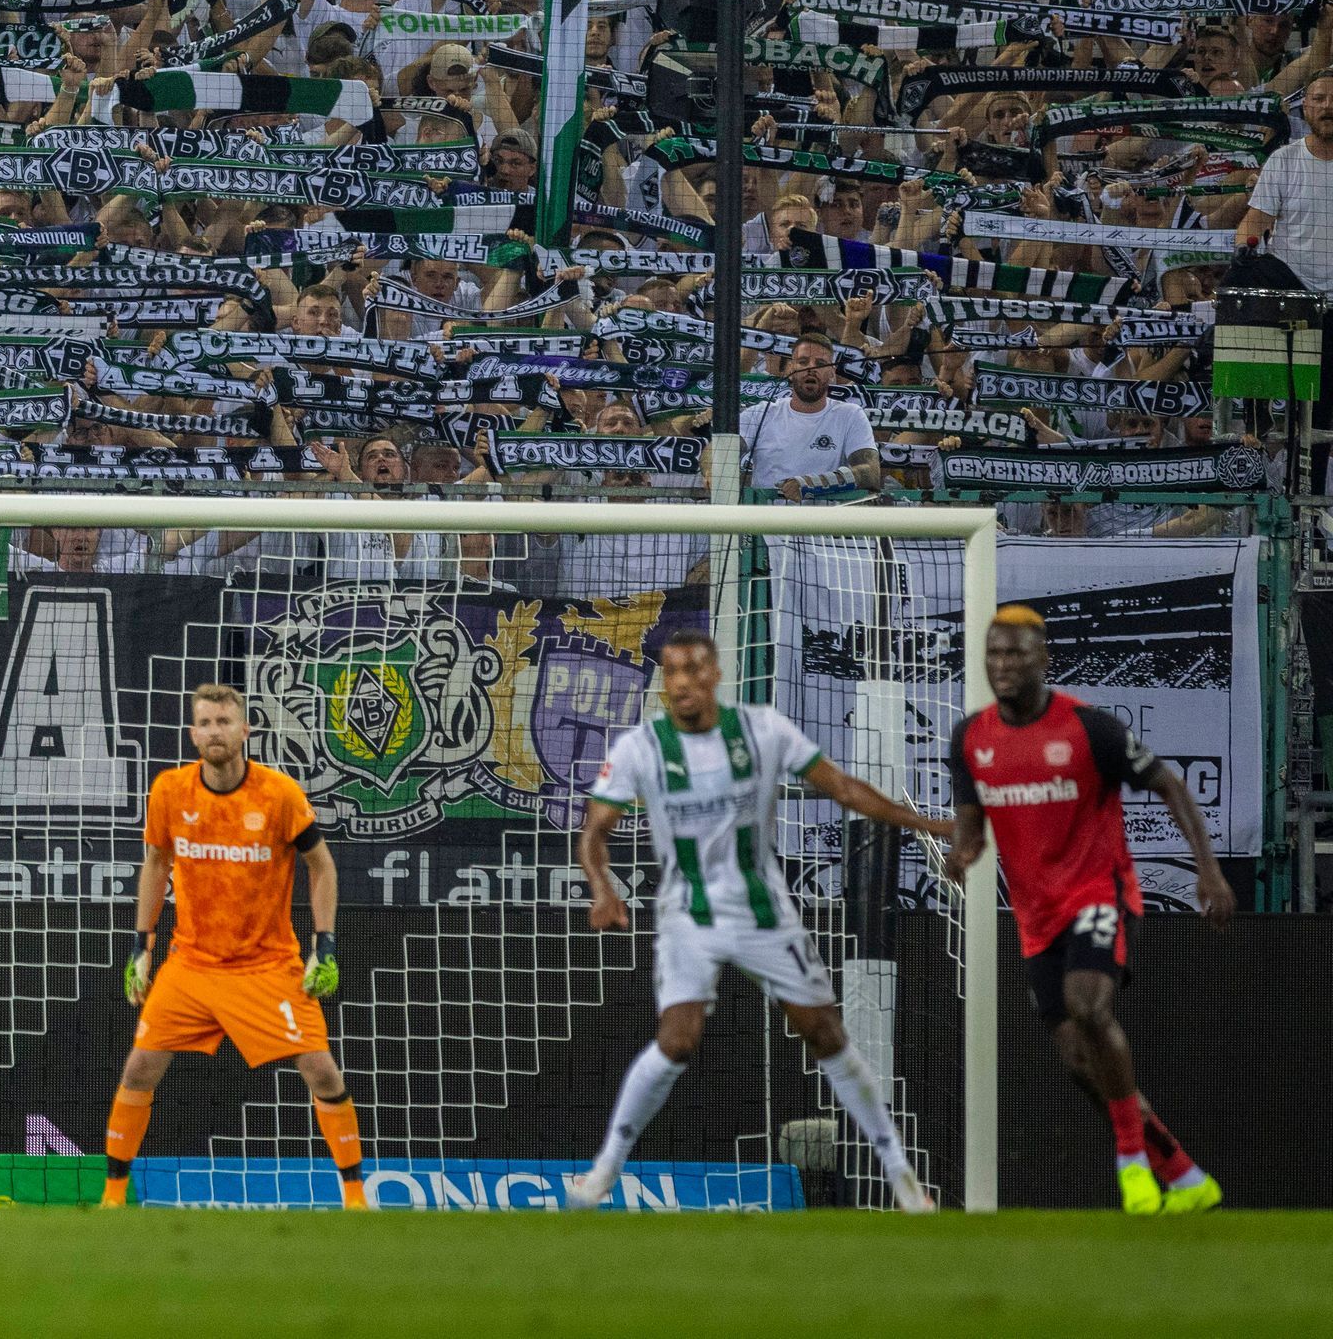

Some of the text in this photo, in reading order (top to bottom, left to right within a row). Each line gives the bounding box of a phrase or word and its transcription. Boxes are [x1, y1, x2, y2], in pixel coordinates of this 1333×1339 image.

[6, 23, 36, 31] SIEG
[942, 68, 1159, 86] BORUSSIA MÖNCHENGLADBACH
[1048, 103, 1087, 121] DIE
[404, 150, 477, 173] FANS
[163, 165, 294, 194] BORUSSIA
[10, 230, 86, 248] zusammen
[388, 234, 409, 253] &
[421, 233, 487, 262] VFL
[979, 374, 1125, 409] BORUSSIA
[500, 437, 643, 465] BORUSSIA
[947, 459, 1214, 494] GEMEINSAM für BORUSSIA
[546, 665, 638, 724] POLI
[174, 836, 272, 866] Barmenia
[1076, 905, 1117, 935] 22
[277, 1000, 296, 1030] 1
